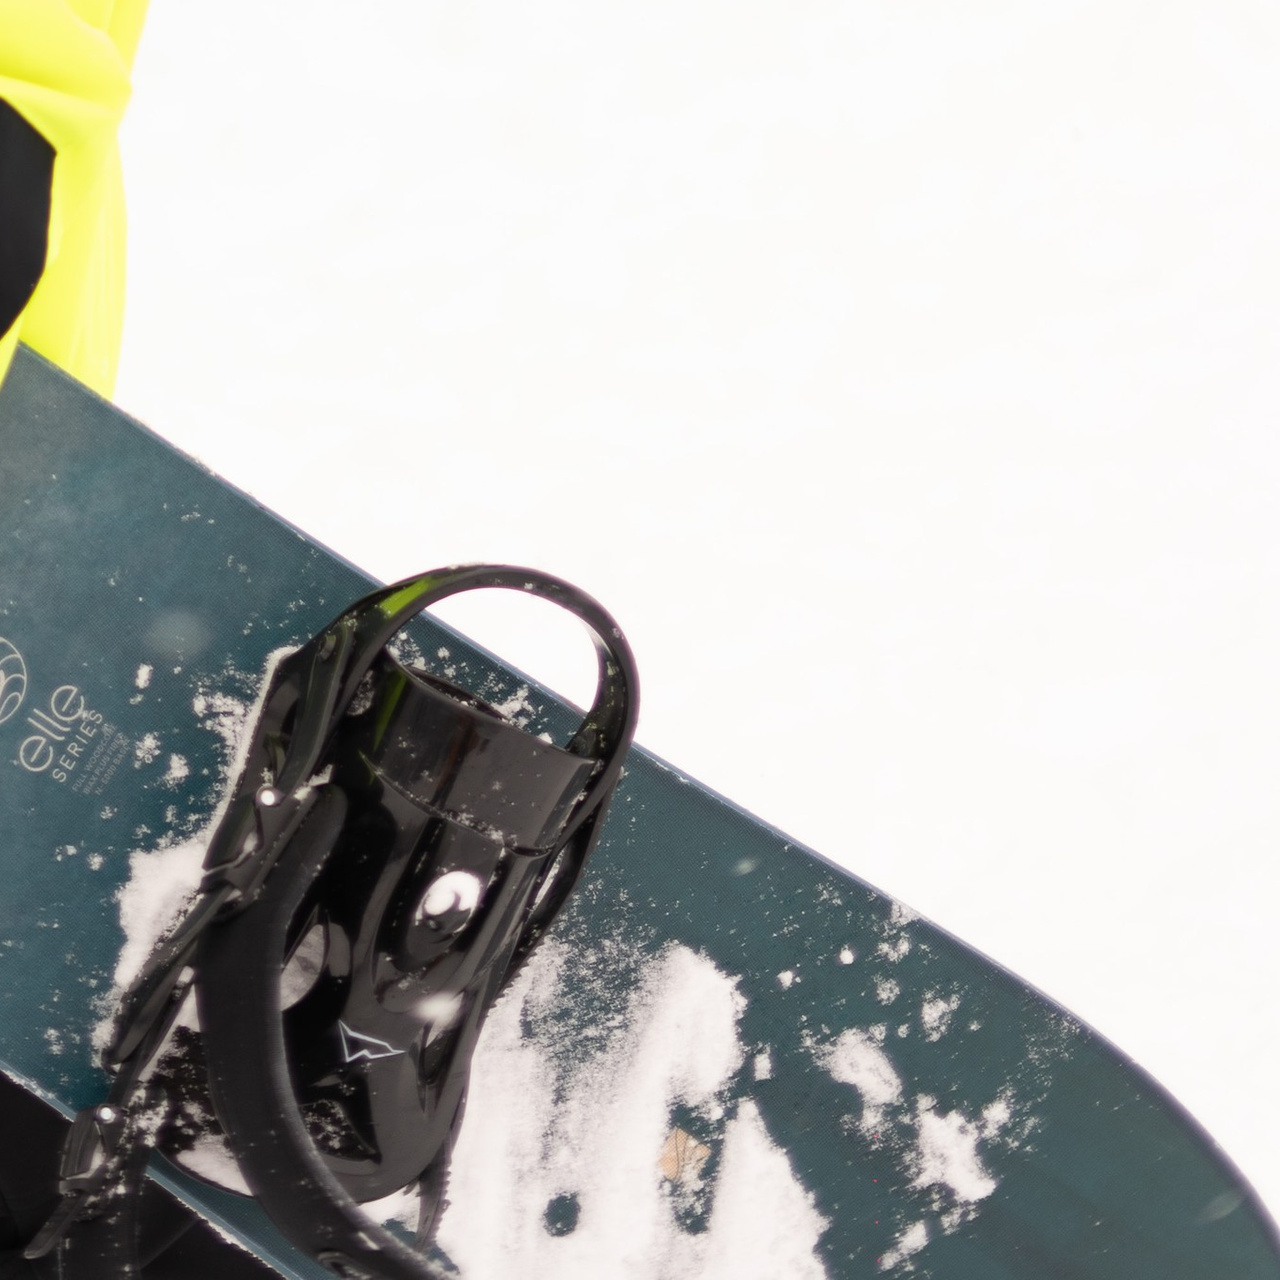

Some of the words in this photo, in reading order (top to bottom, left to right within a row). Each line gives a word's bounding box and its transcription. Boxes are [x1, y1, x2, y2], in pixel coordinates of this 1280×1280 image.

[19, 684, 85, 772] elle
[51, 710, 103, 783] SERIES
[93, 757, 109, 778] PLUS
